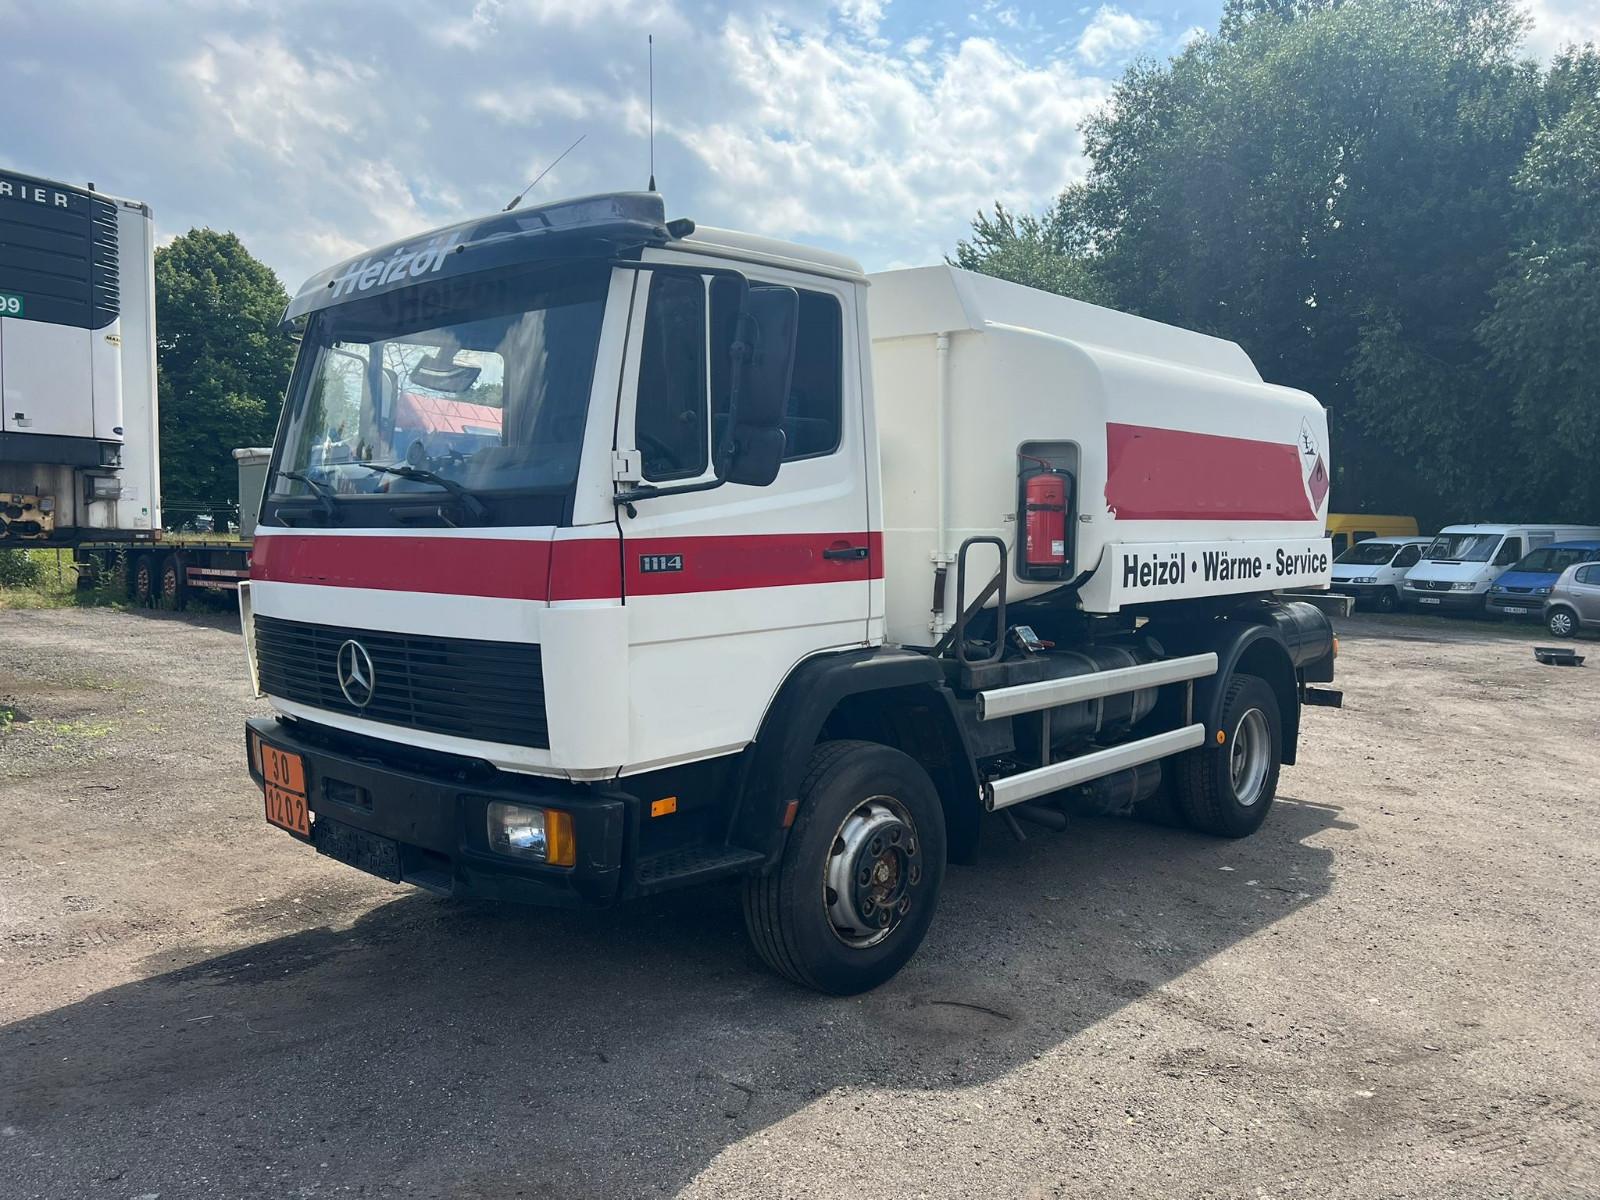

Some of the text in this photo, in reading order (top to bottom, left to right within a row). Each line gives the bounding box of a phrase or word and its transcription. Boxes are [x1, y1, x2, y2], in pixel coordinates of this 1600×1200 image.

[0, 181, 68, 208] RIER
[332, 232, 461, 298] Heizöl
[643, 556, 681, 571] 1114
[1123, 552, 1186, 588] Heizöl
[1203, 551, 1262, 582] Wärme
[1276, 547, 1328, 576] Service
[271, 751, 290, 785] 30
[268, 789, 306, 831] 1202
